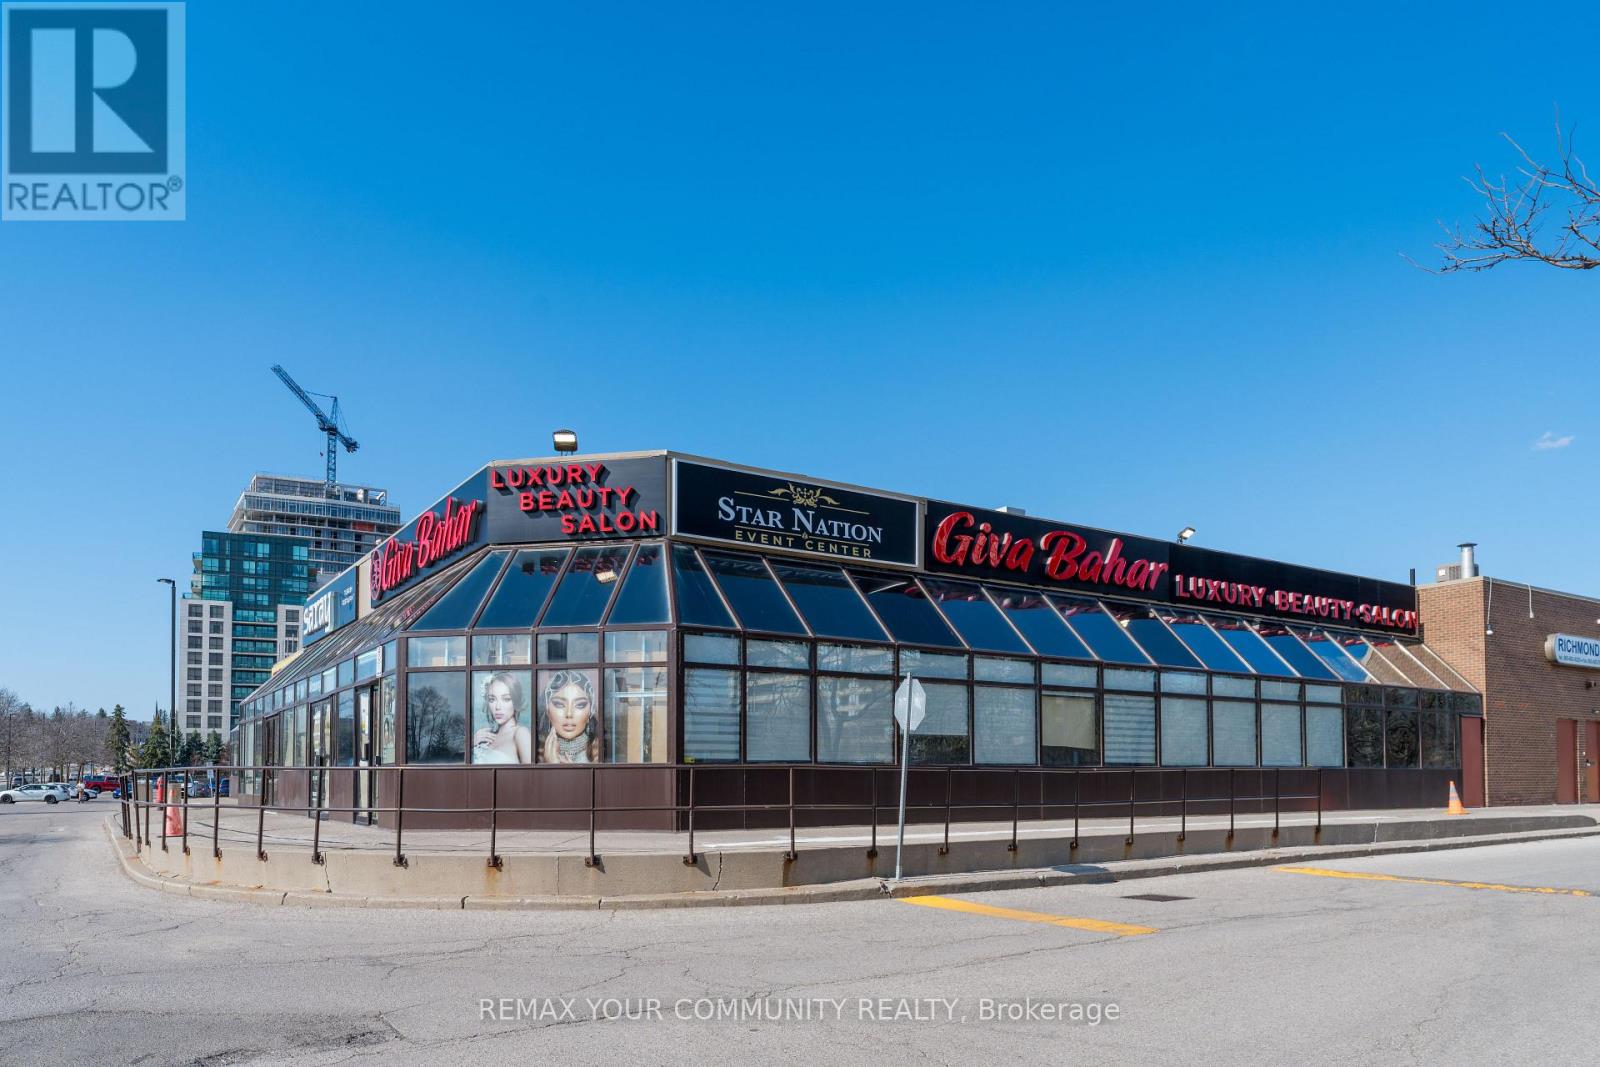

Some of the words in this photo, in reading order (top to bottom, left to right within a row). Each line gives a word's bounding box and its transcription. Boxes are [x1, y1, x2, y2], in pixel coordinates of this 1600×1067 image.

[491, 463, 604, 489] LUXURY
[519, 486, 636, 511] BEAUTY
[561, 510, 657, 534] SALON
[381, 538, 414, 591] Giva
[416, 496, 478, 568] Bahar
[735, 530, 794, 548] EVENT
[805, 539, 872, 559] CENTER
[933, 511, 1034, 573] Giva
[1039, 530, 1169, 591] Bahar
[1175, 574, 1267, 607] LUXURY
[1275, 590, 1355, 620] BEAUTY
[1360, 604, 1417, 629] SALON
[1558, 638, 1600, 657] RICHMOND
